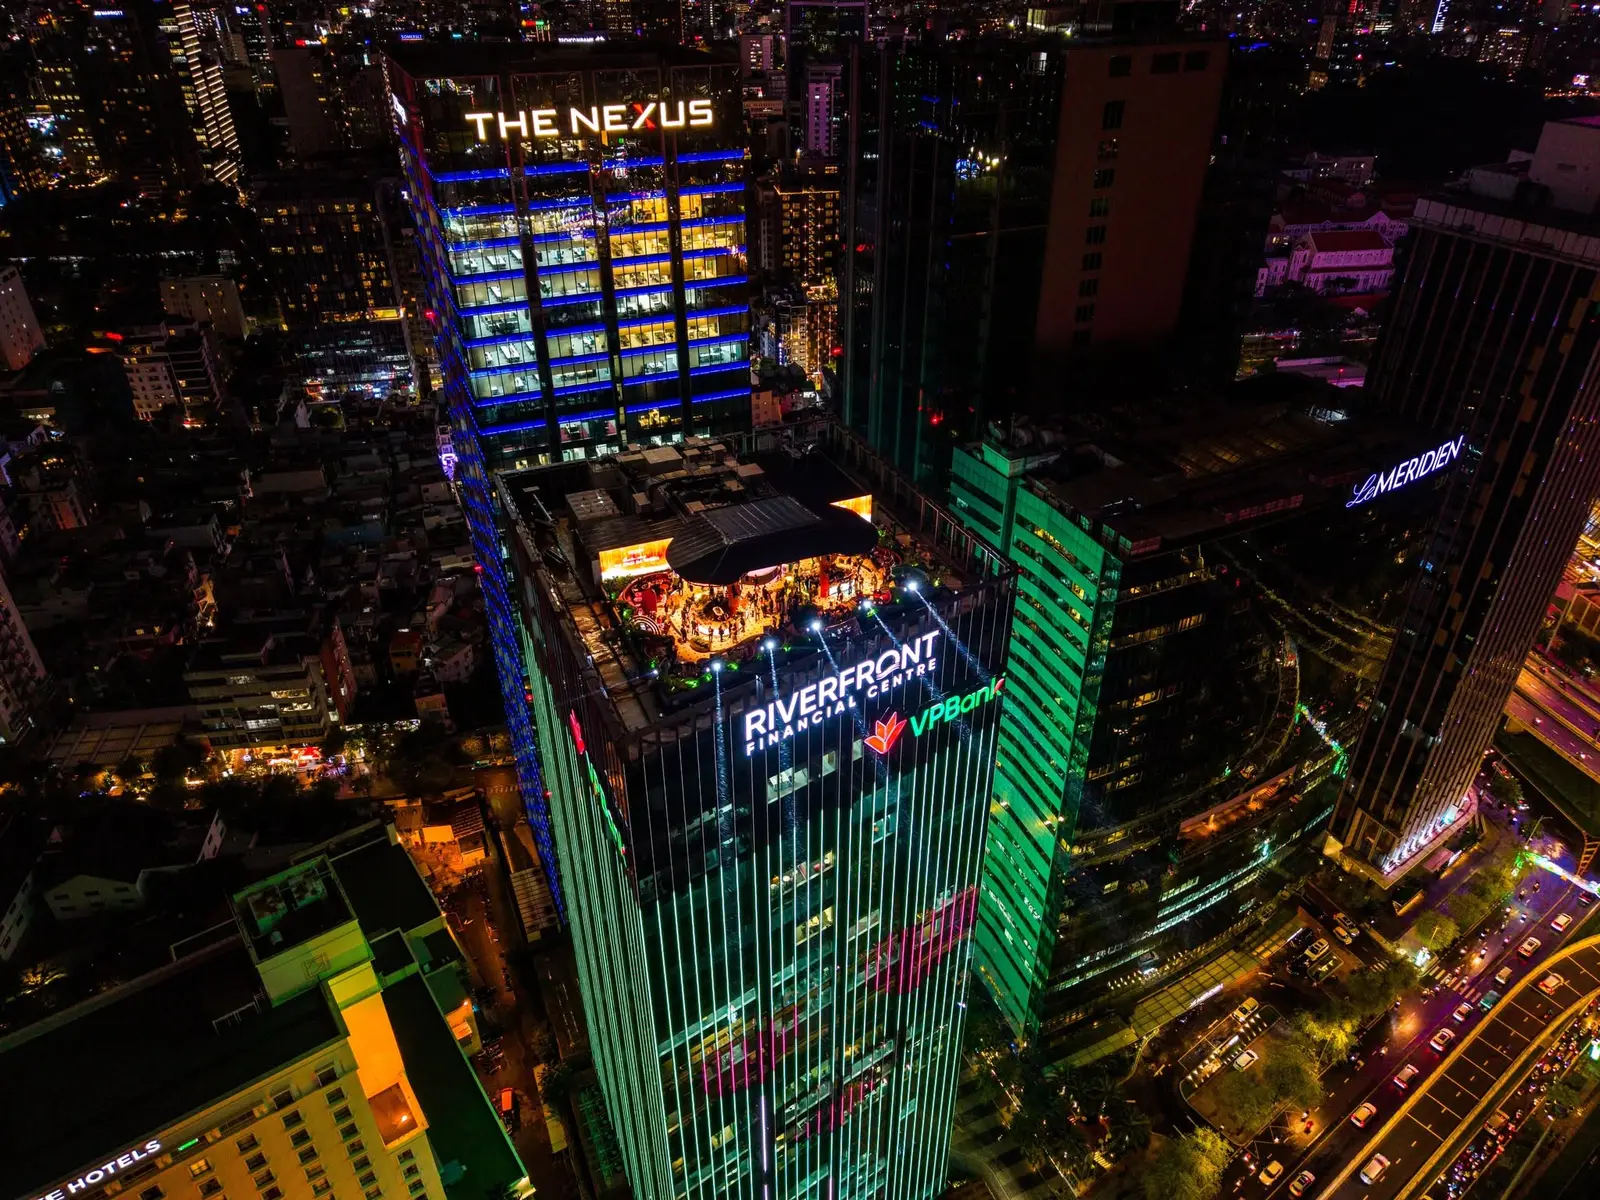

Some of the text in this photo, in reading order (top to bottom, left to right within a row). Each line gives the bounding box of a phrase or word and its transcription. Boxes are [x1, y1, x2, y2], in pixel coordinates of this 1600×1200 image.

[465, 99, 713, 141] THE NEXUS
[745, 629, 940, 741] RIVERFRONT
[745, 658, 937, 756] FINANCIAL CENTRE
[910, 672, 1007, 738] VPBank
[67, 1139, 162, 1194] HOTELS
